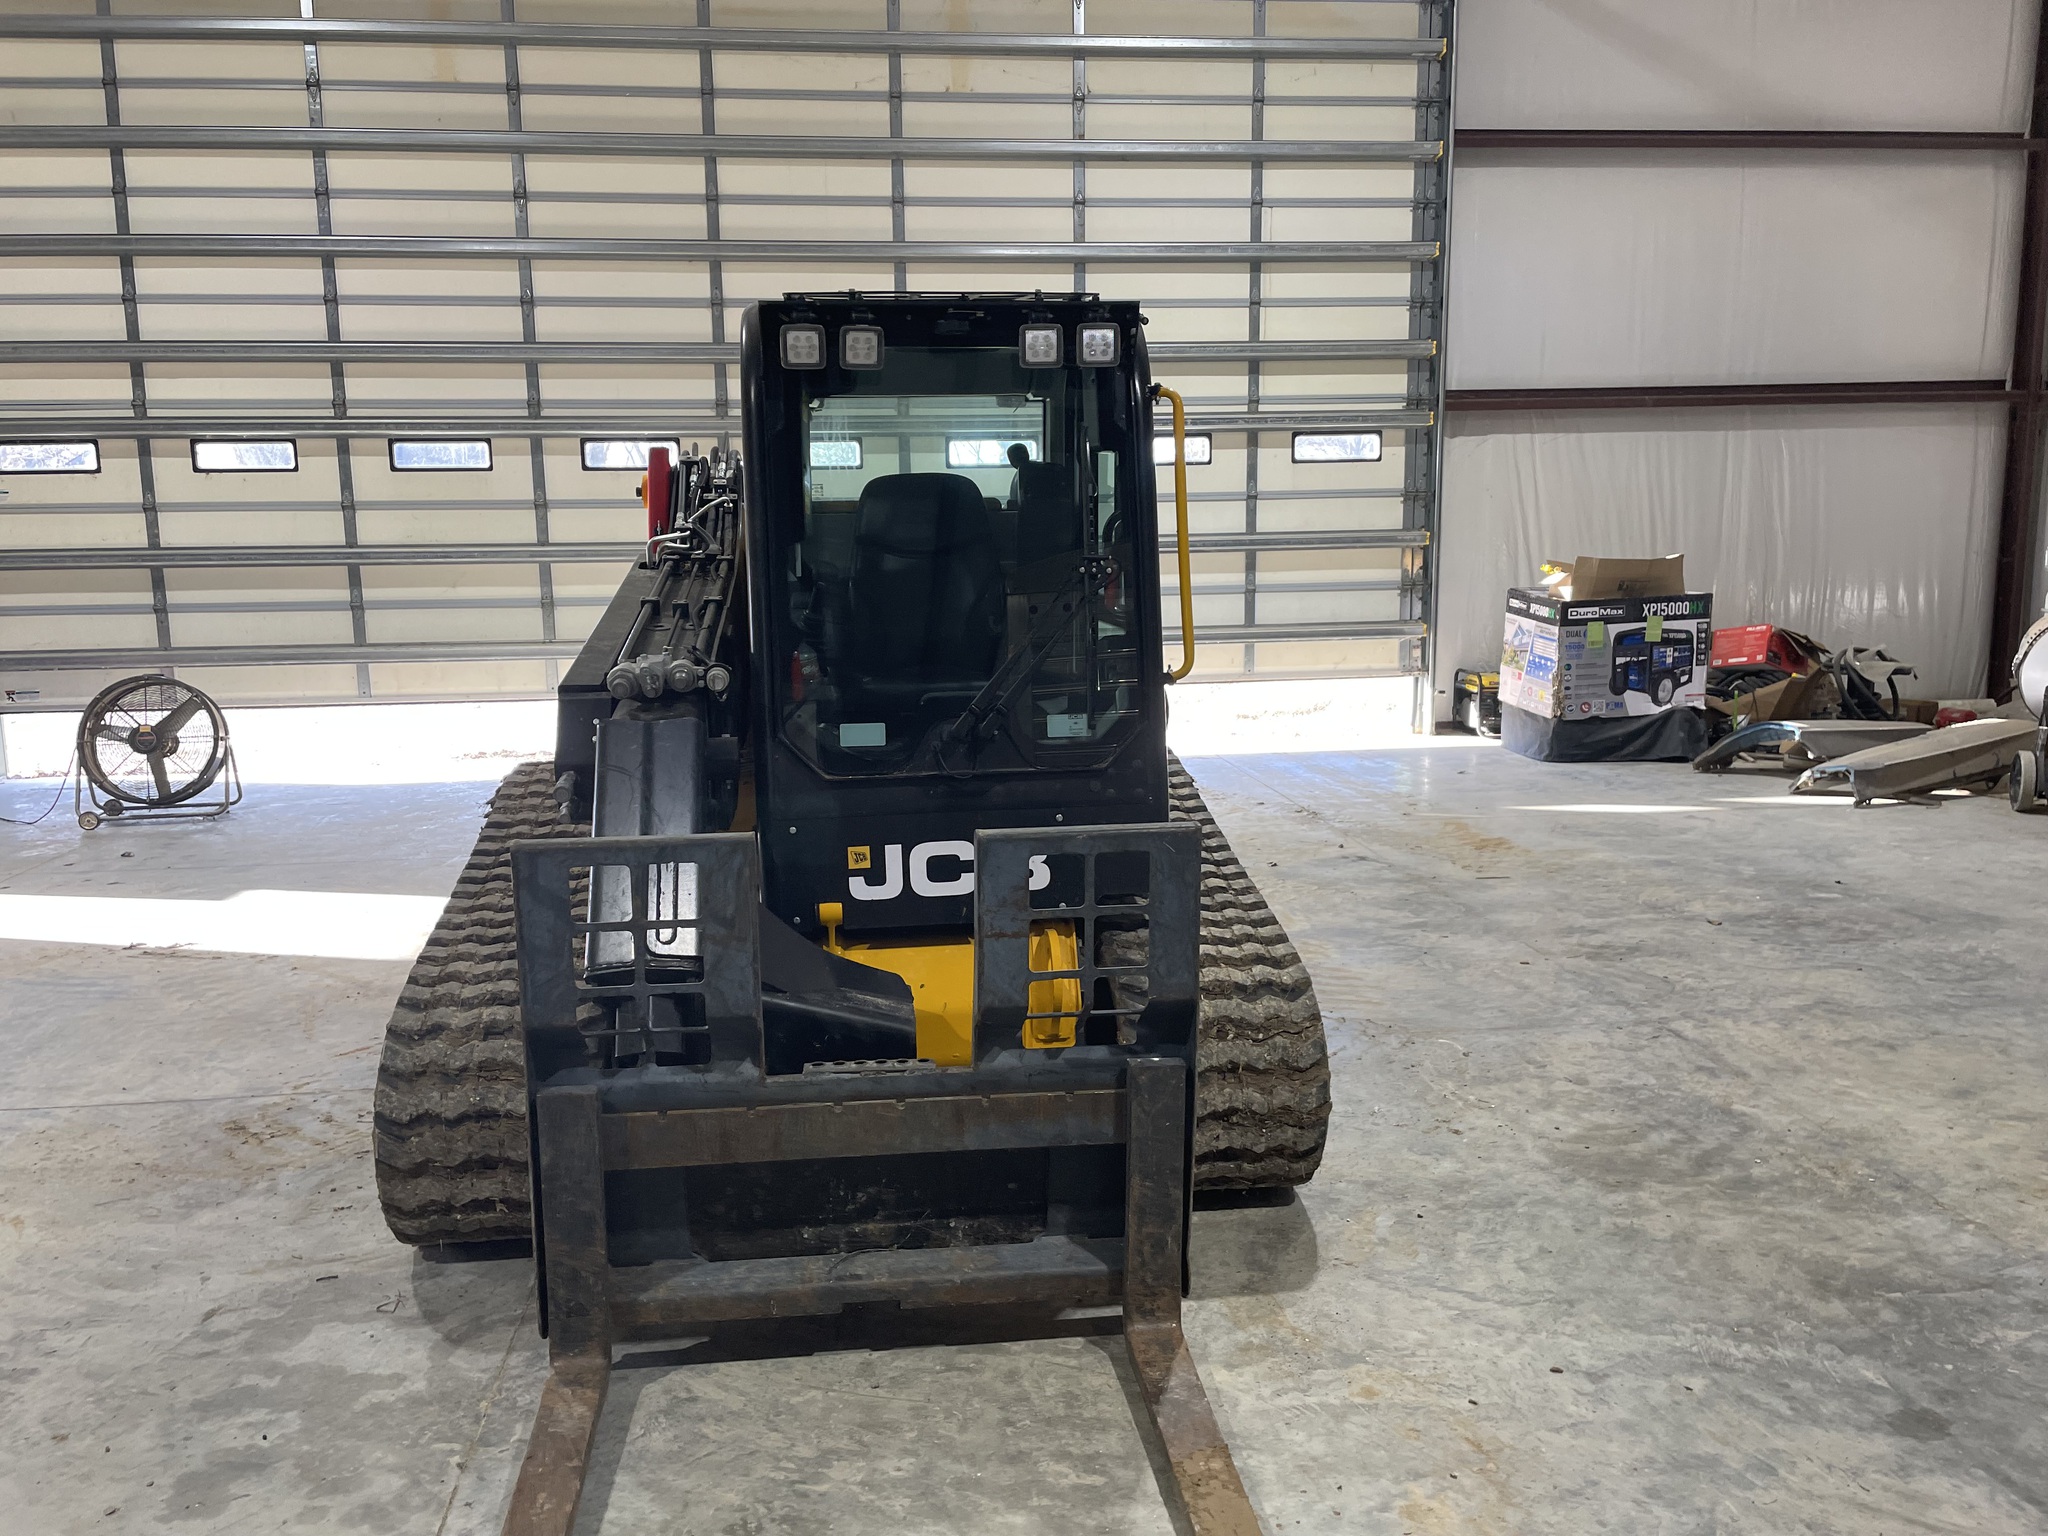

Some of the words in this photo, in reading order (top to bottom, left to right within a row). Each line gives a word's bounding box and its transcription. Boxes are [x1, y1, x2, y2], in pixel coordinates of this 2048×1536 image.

[1569, 607, 1624, 618] DuroMax
[1642, 601, 1704, 617] XP15000HX
[1566, 630, 1582, 638] DUAL
[853, 851, 868, 863] JCB
